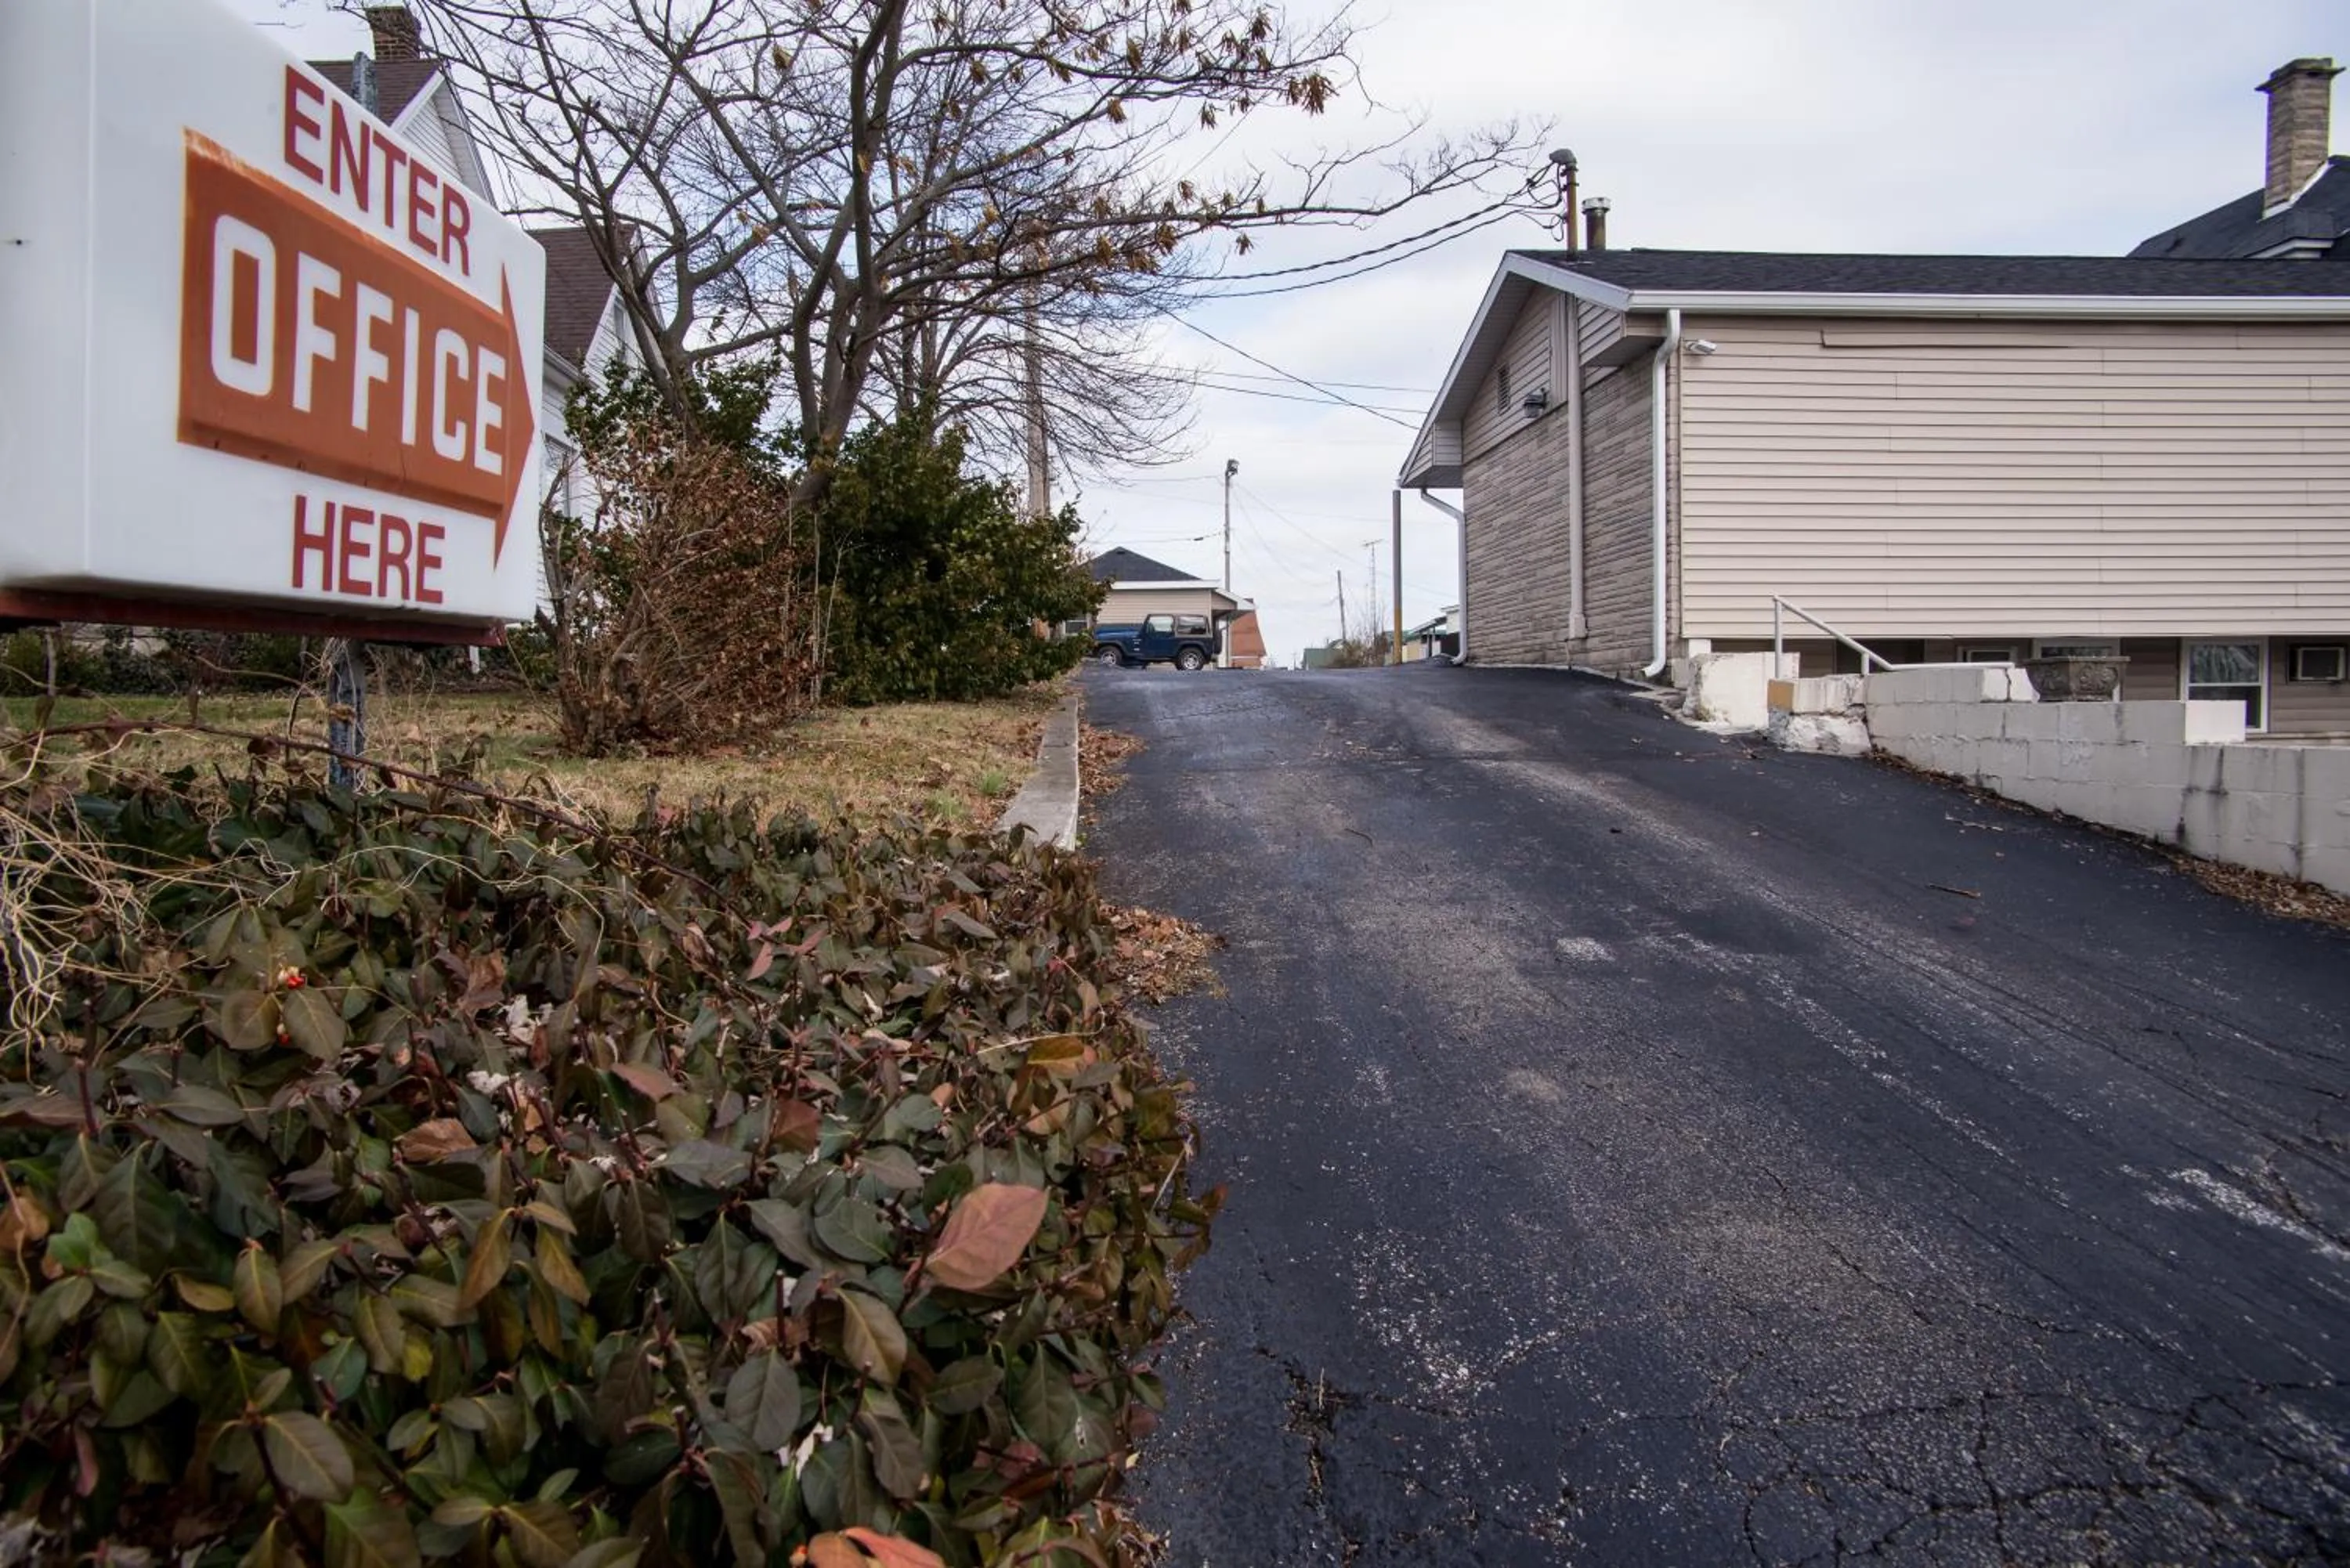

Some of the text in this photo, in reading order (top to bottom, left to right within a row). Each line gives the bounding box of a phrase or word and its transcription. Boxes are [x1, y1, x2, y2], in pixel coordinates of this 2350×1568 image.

[284, 64, 472, 276] ENTER
[211, 214, 506, 475] OFFICE
[292, 495, 446, 604] HERE
